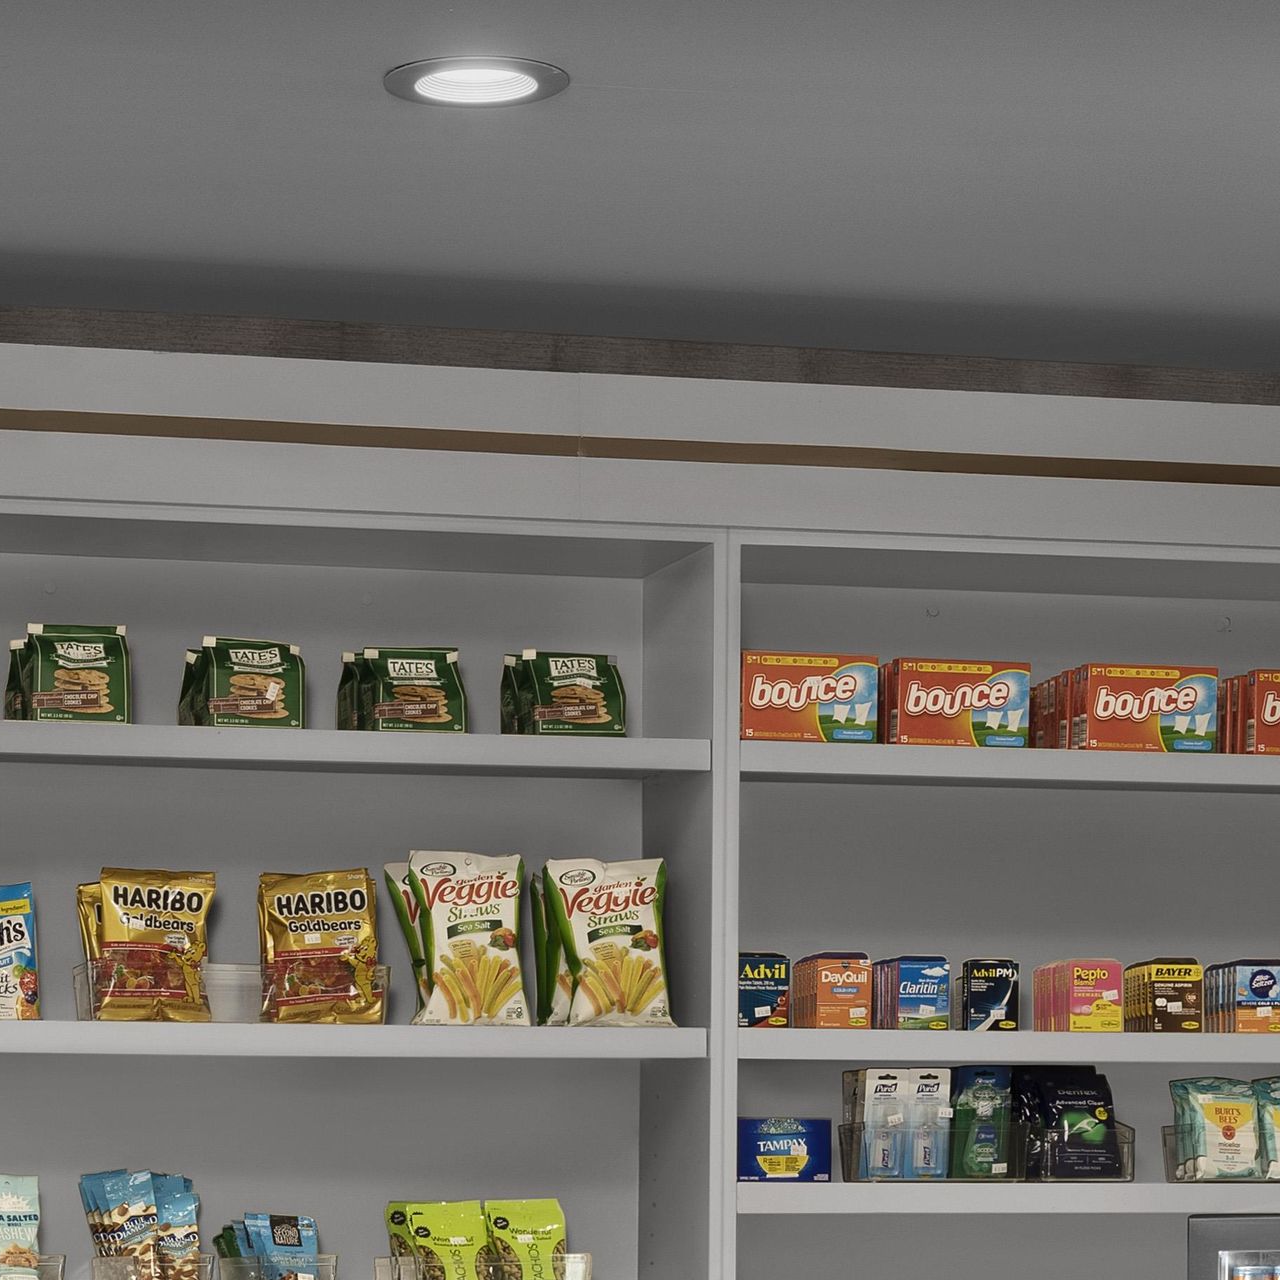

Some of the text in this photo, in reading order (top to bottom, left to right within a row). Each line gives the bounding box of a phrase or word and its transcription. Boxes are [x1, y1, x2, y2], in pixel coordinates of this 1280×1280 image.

[231, 648, 279, 662] TATE'S
[750, 674, 856, 709] bounce
[906, 681, 1009, 716] bounce
[1095, 686, 1197, 721] bounce
[421, 878, 519, 911] Veggie
[593, 882, 632, 895] garden
[113, 886, 203, 912] HARIBO
[276, 890, 365, 916] HARIBO
[560, 886, 658, 920] Veggie
[588, 910, 639, 928] Straws
[288, 920, 361, 933] Goldbears
[741, 964, 786, 979] Advil
[821, 971, 867, 984] DayQuil
[971, 969, 1012, 979] Advil PM
[1074, 968, 1108, 981] Pepto
[1155, 968, 1192, 976] BAYER
[900, 982, 937, 994] Claritin
[1215, 1107, 1241, 1116] BURT'S
[1219, 1115, 1238, 1124] BEES
[757, 1138, 806, 1152] TAMPAX
[7, 1213, 39, 1222] SALTED
